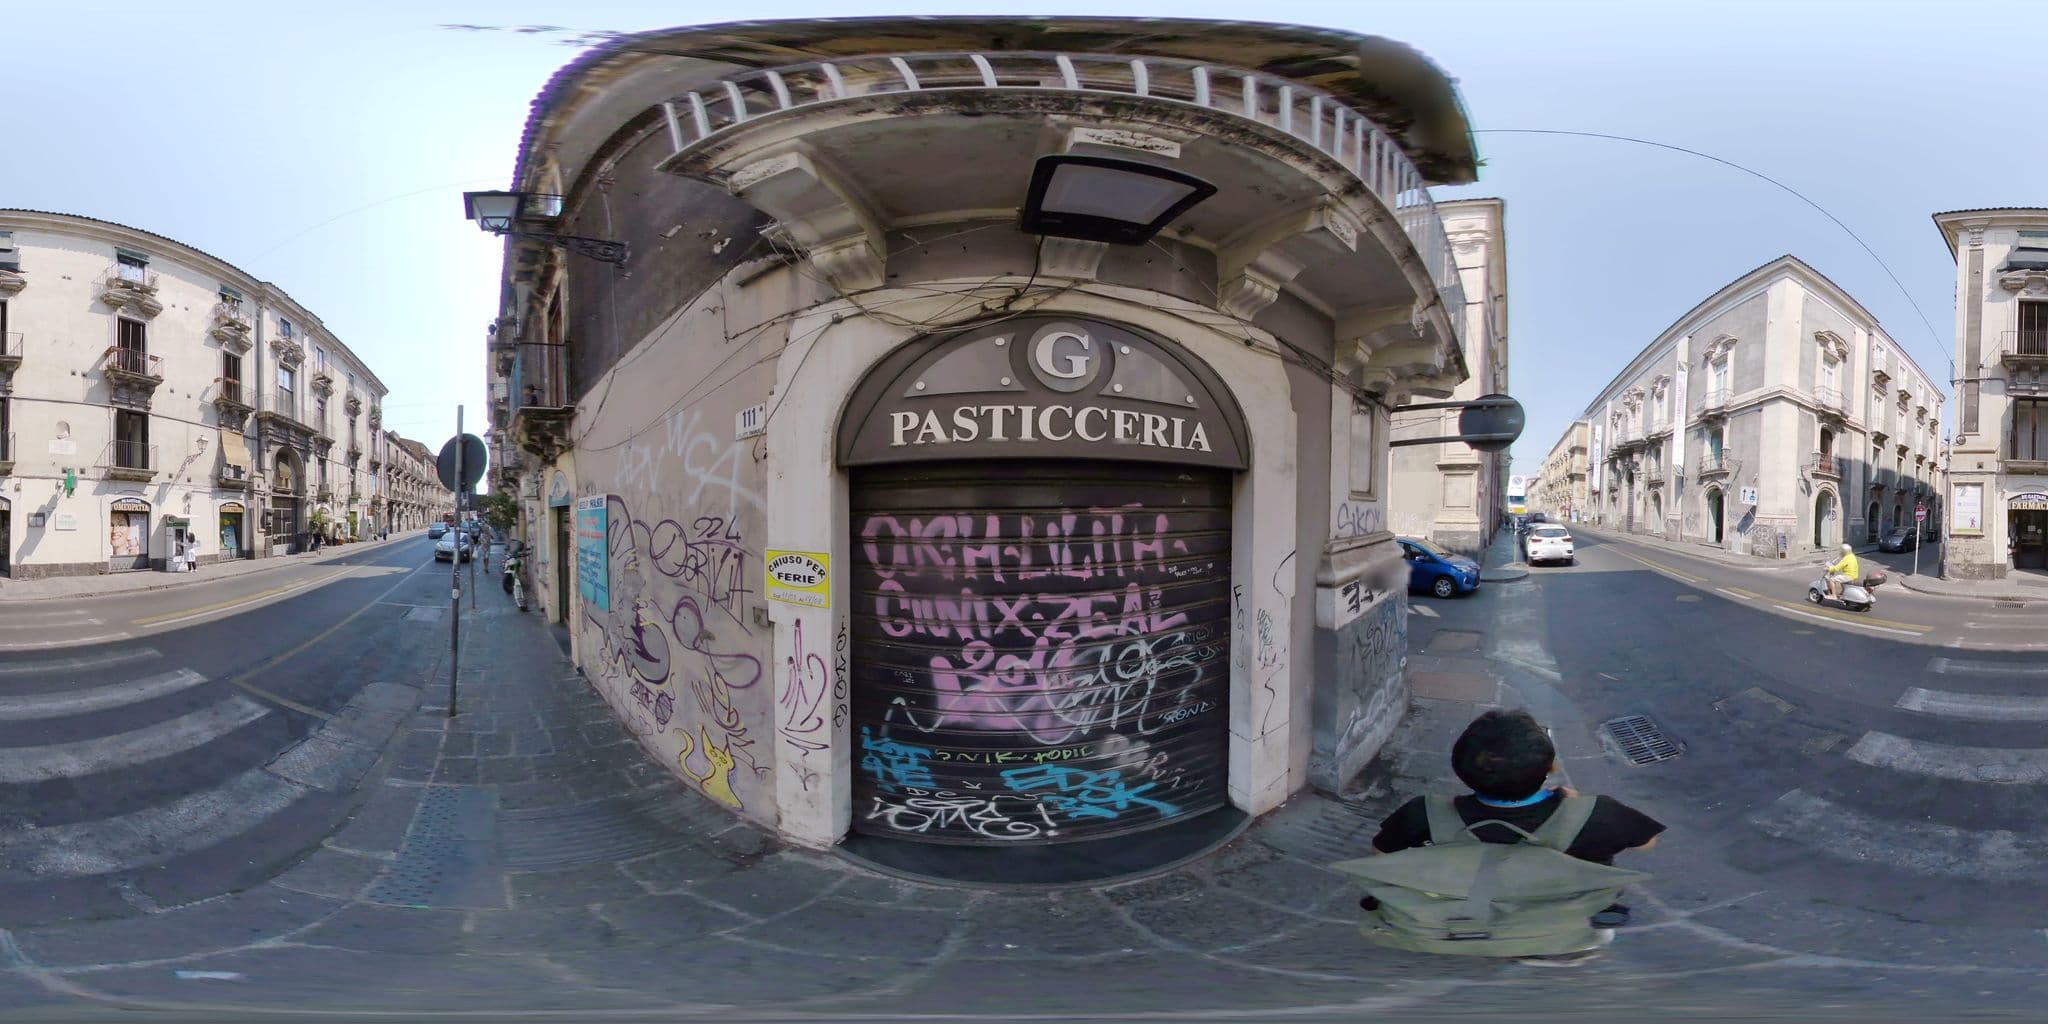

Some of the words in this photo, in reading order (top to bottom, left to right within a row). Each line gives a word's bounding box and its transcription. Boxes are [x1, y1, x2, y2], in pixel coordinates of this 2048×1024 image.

[1035, 331, 1090, 379] G
[889, 404, 1213, 452] PASTICCERIA
[768, 555, 802, 572] CHIUSO
[806, 559, 826, 578] PER
[777, 572, 816, 584] FERIE
